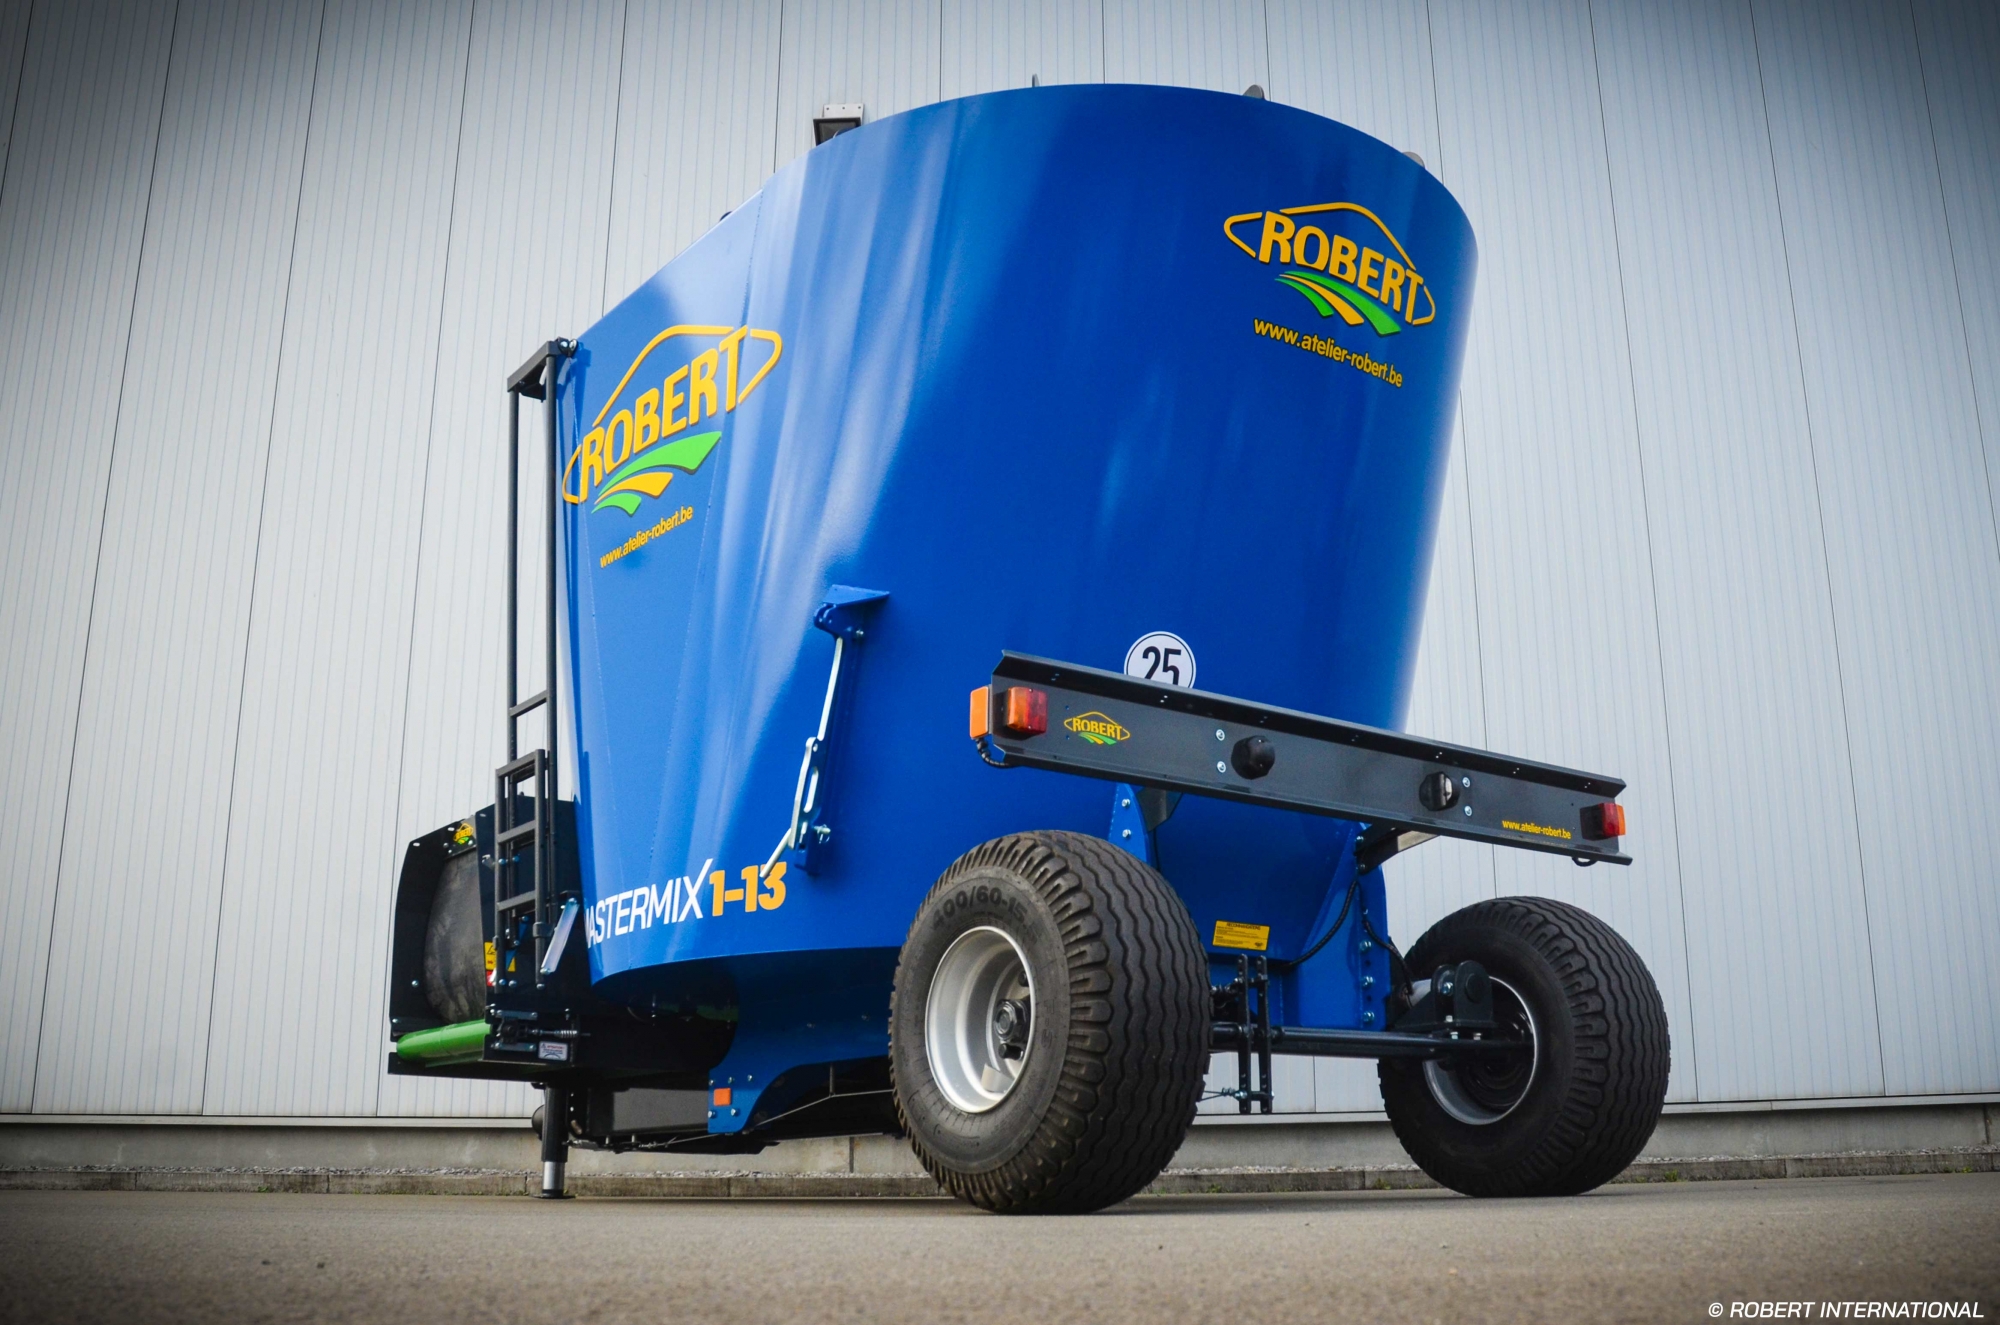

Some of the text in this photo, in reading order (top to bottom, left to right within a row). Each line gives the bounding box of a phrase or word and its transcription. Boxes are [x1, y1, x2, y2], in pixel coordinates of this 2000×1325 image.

[1258, 210, 1424, 324] ROBERT
[1254, 319, 1403, 388] www.atelier-robert.be
[578, 325, 748, 503] ROBERT
[599, 505, 694, 568] www.atelier-robert.be
[1142, 645, 1182, 686] 25
[1072, 717, 1123, 741] ROBERT
[1502, 820, 1571, 839] www.atelier-robert.be
[709, 861, 787, 916] 1-13
